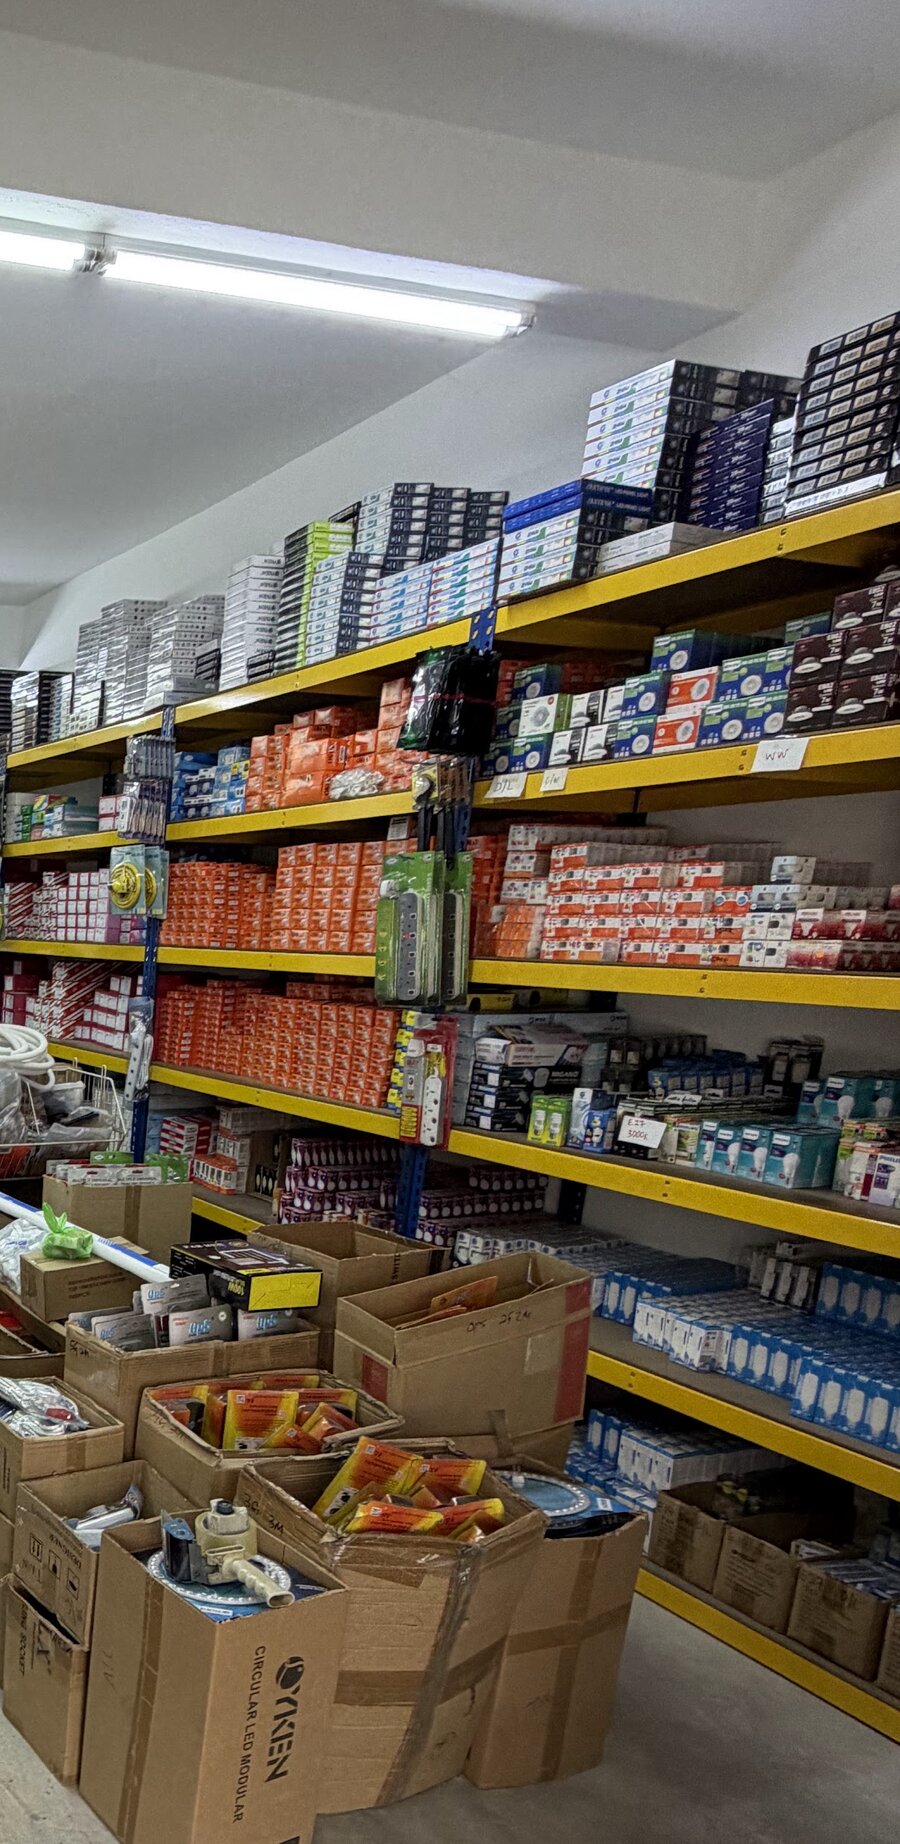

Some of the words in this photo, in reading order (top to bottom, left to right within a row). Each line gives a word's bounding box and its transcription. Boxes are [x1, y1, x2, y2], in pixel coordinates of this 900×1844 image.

[246, 1645, 266, 1721] CIRCULAR
[242, 1722, 256, 1751] LED
[232, 1753, 252, 1824] MODULAR
